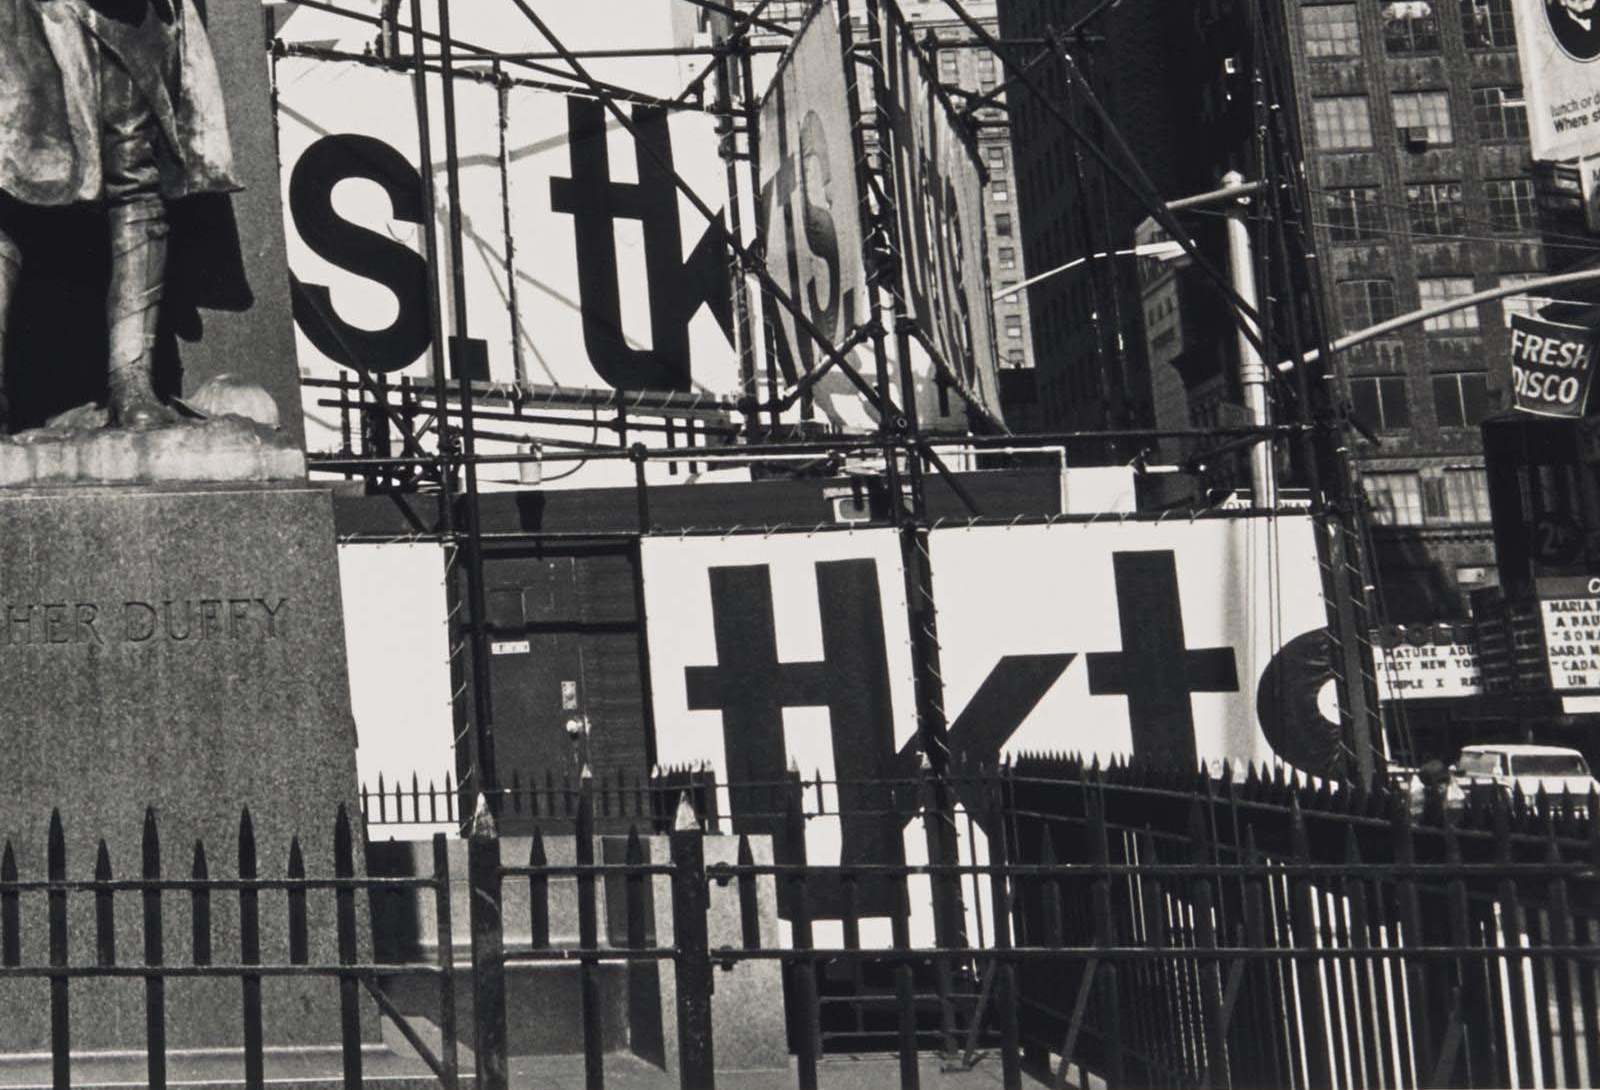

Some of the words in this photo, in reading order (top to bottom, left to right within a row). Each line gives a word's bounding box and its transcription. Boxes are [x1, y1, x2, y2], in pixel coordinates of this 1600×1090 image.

[1550, 99, 1579, 117] lunch
[1581, 97, 1592, 108] or
[1554, 115, 1588, 133] Where
[1512, 328, 1590, 370] FRESH
[1512, 365, 1579, 404] DISCO
[1550, 601, 1592, 613] MARIA
[122, 596, 289, 645] DUFFY
[1550, 645, 1584, 657] SARA
[1421, 659, 1447, 670] NEW
[1436, 678, 1445, 688] X
[1568, 675, 1587, 686] UN
